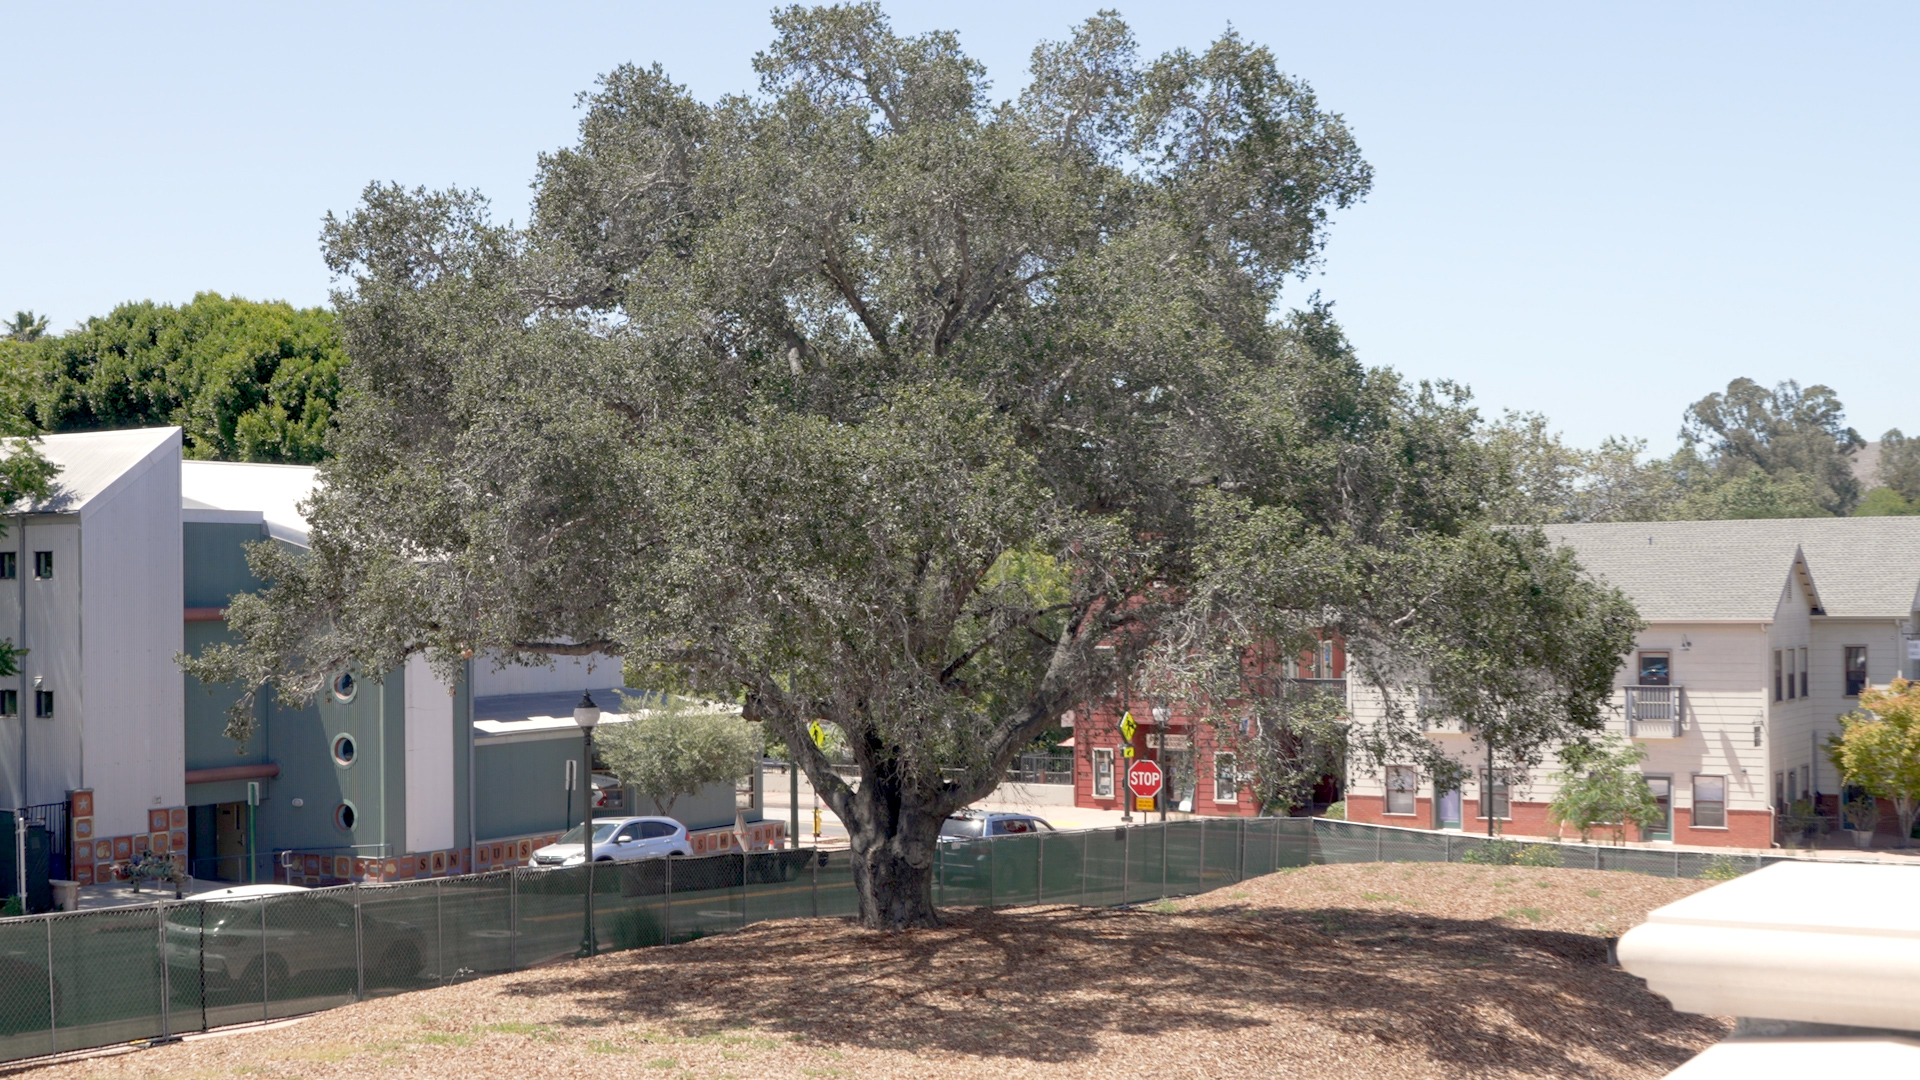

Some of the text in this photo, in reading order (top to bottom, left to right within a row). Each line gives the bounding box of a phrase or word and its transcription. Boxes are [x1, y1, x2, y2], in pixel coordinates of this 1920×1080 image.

[1130, 771, 1160, 786] STOP
[420, 854, 458, 870] SAN
[479, 844, 528, 862] LUIS
[720, 825, 784, 844] MUEUM
